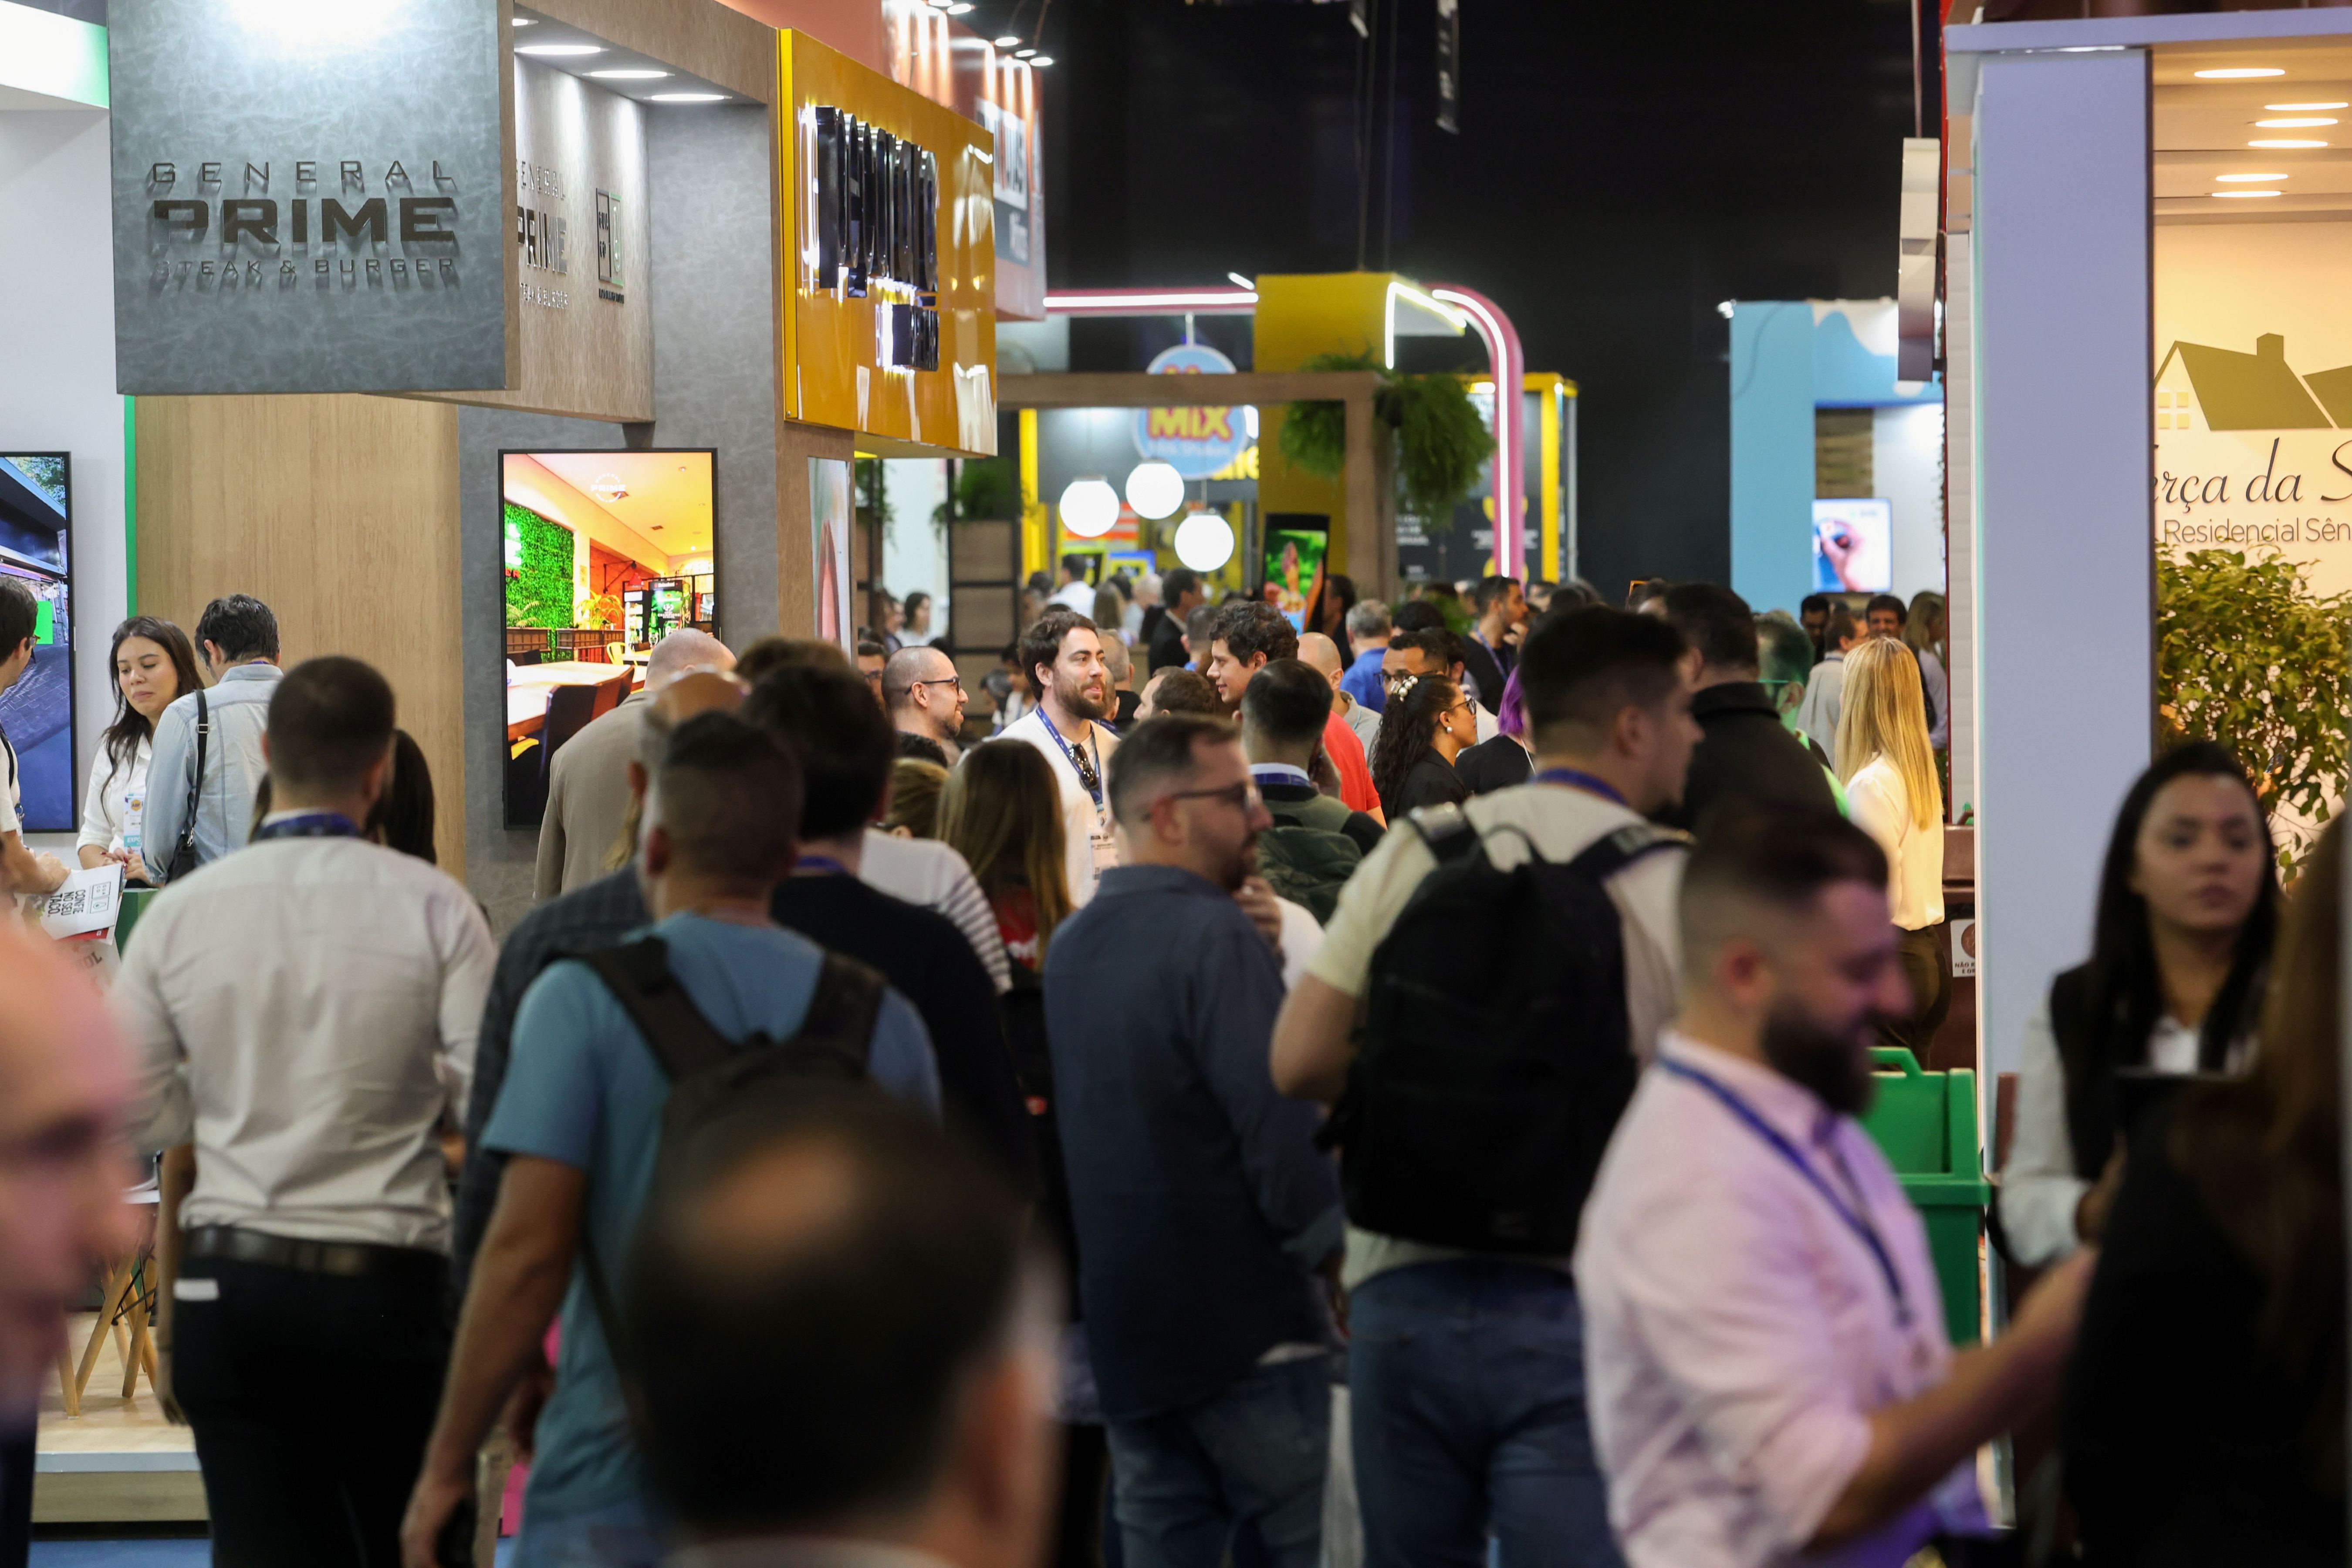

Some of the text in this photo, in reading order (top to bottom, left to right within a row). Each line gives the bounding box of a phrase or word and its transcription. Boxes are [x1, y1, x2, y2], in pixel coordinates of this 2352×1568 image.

[152, 160, 452, 183] GENERAL
[516, 159, 565, 201] ENERAL
[154, 196, 454, 245] PRIME
[315, 258, 454, 274] BURGER
[590, 484, 626, 492] PRIME
[2154, 444, 2230, 514] rça
[2245, 437, 2303, 502] da
[2164, 517, 2299, 543] Residencial
[61, 892, 74, 916] NO SEU
[73, 889, 86, 914] CONFIE
